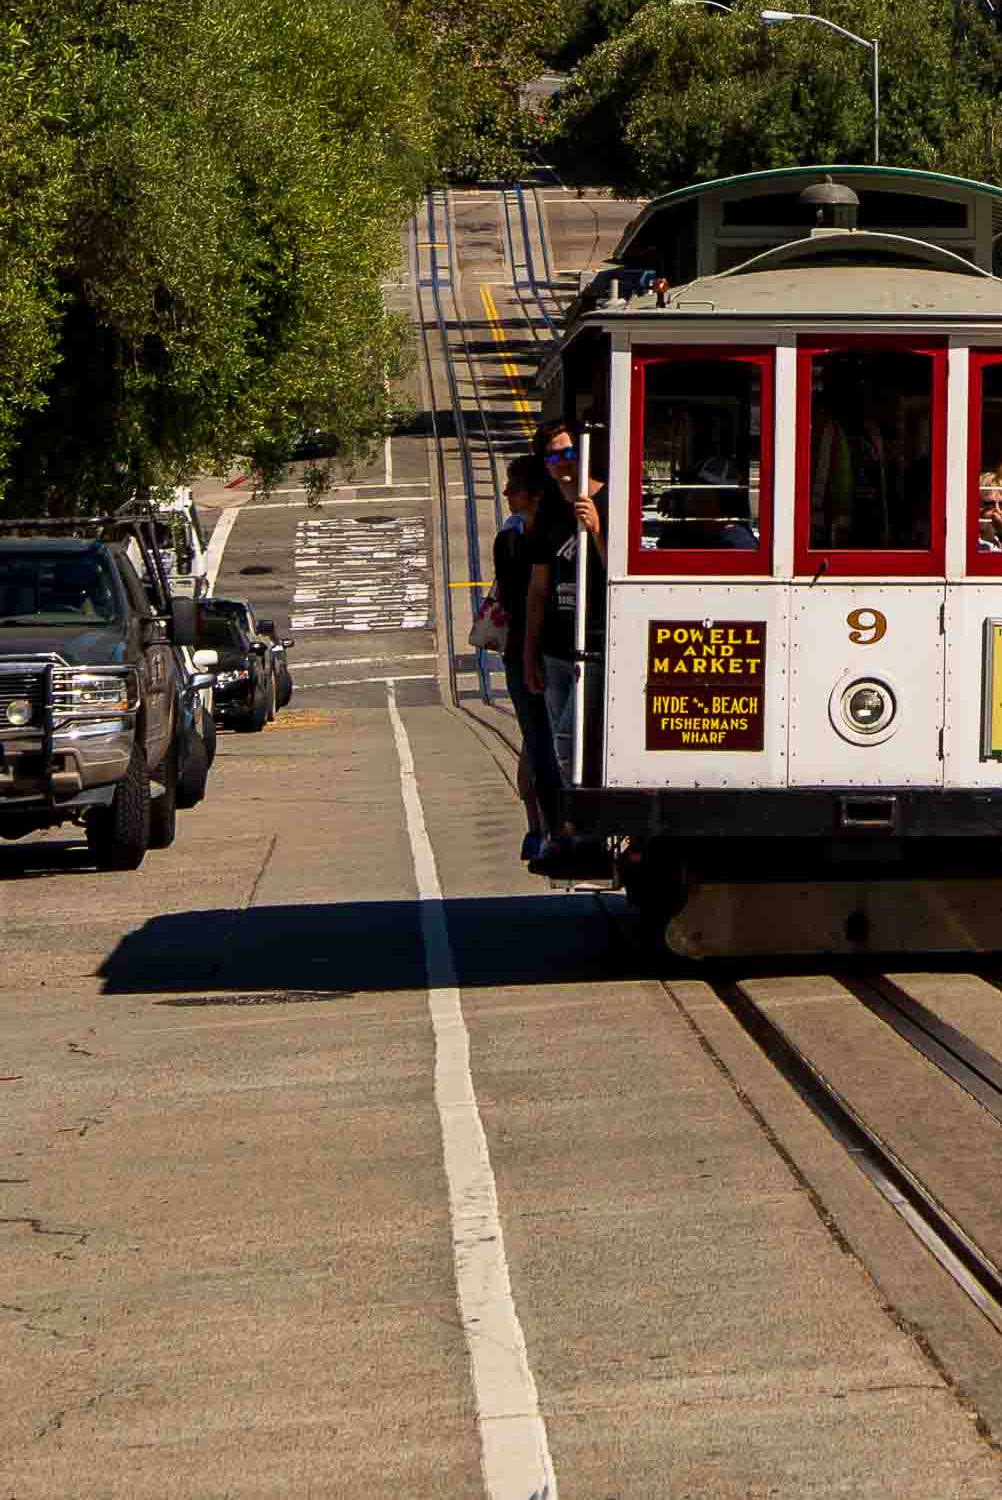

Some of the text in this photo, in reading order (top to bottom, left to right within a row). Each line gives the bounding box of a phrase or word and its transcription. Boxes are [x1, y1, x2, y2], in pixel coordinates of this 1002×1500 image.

[846, 607, 888, 645] 9
[656, 628, 761, 645] POWELL
[682, 644, 735, 657] AND
[653, 657, 761, 674] MARKET
[653, 695, 689, 714] HYDE
[711, 695, 758, 714] BEACH
[661, 717, 749, 731] FISHERMANS
[681, 731, 727, 744] WHARF
